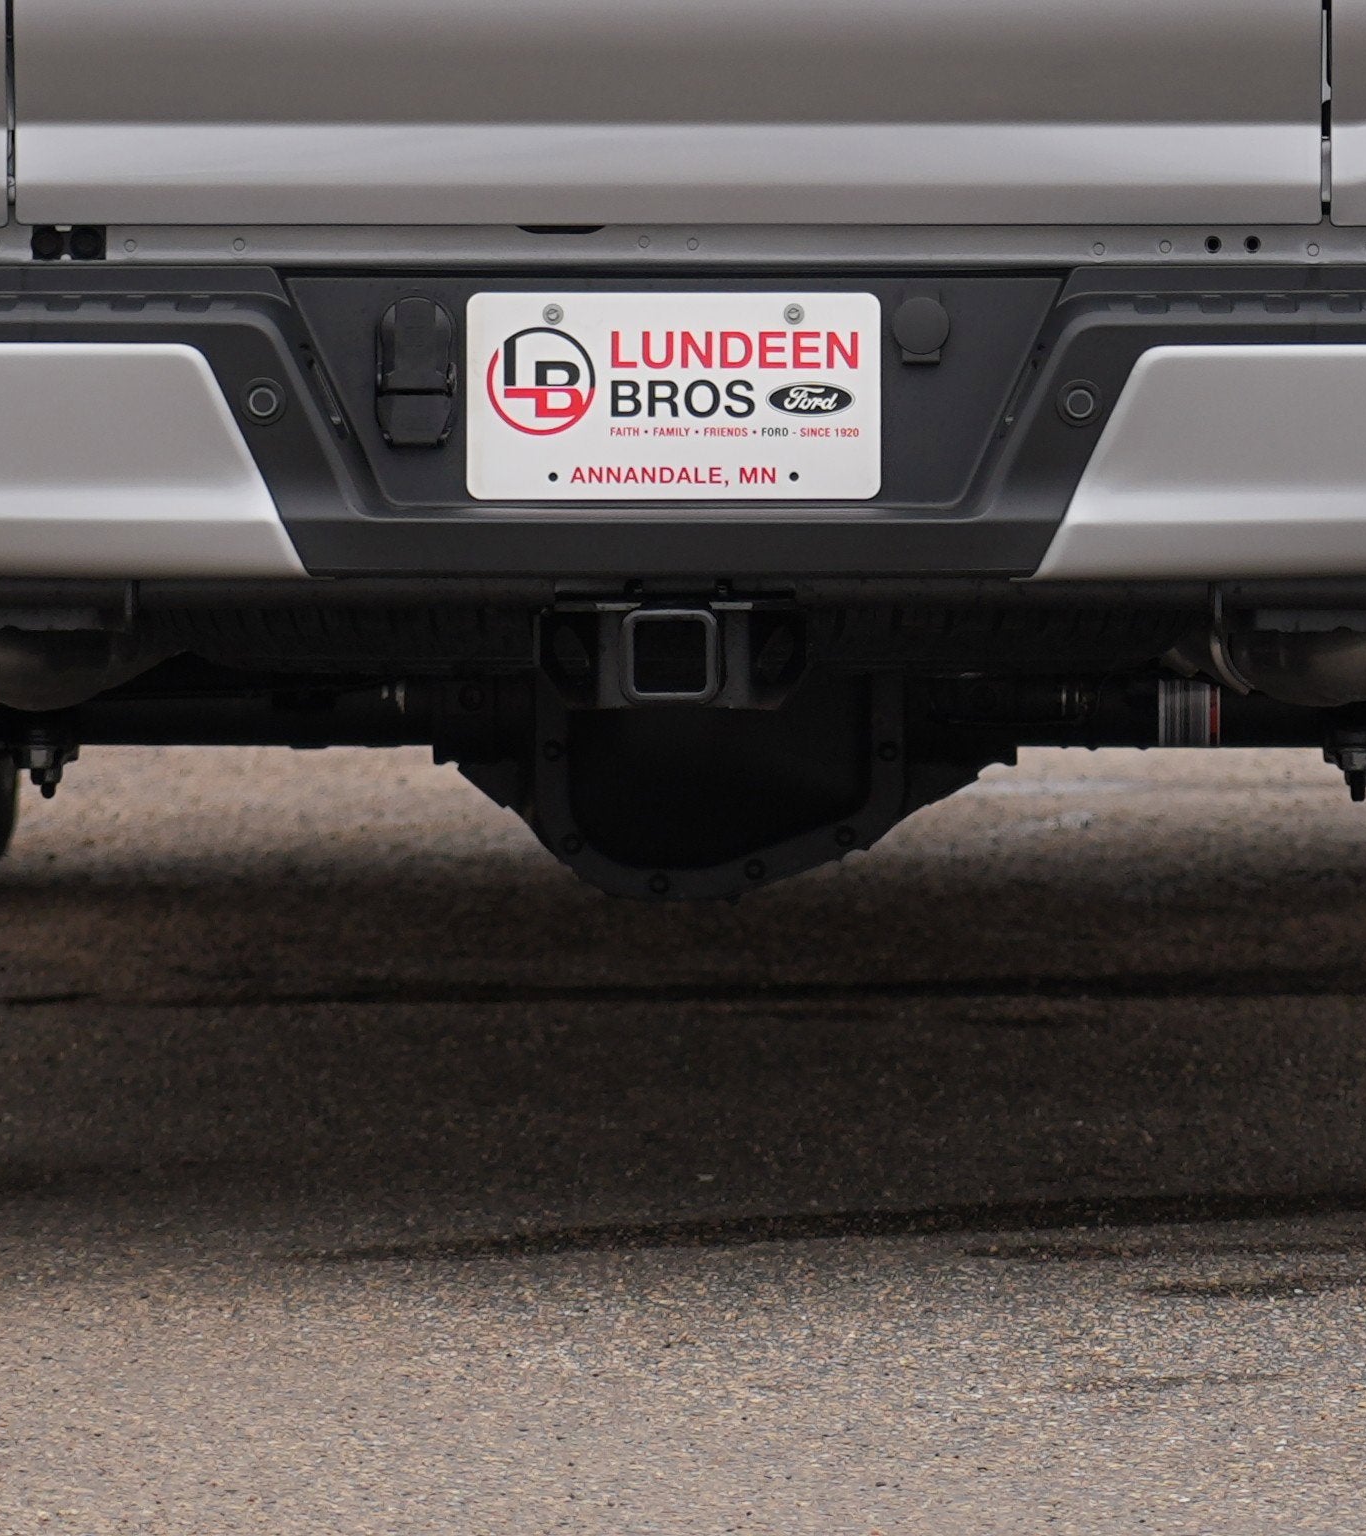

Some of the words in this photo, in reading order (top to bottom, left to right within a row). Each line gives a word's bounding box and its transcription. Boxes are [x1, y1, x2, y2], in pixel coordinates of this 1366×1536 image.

[610, 330, 859, 370] LUNDEEN
[610, 379, 756, 419] BROS
[783, 386, 839, 411] Ford
[610, 426, 641, 438] FAITH
[653, 426, 691, 438] FAMILY
[703, 426, 749, 438] FRIENDS
[761, 426, 790, 438] FORD
[799, 426, 832, 438] SINCE
[835, 426, 860, 438] 1920
[570, 466, 730, 487] ANNANDALE,
[739, 466, 777, 485] MN
